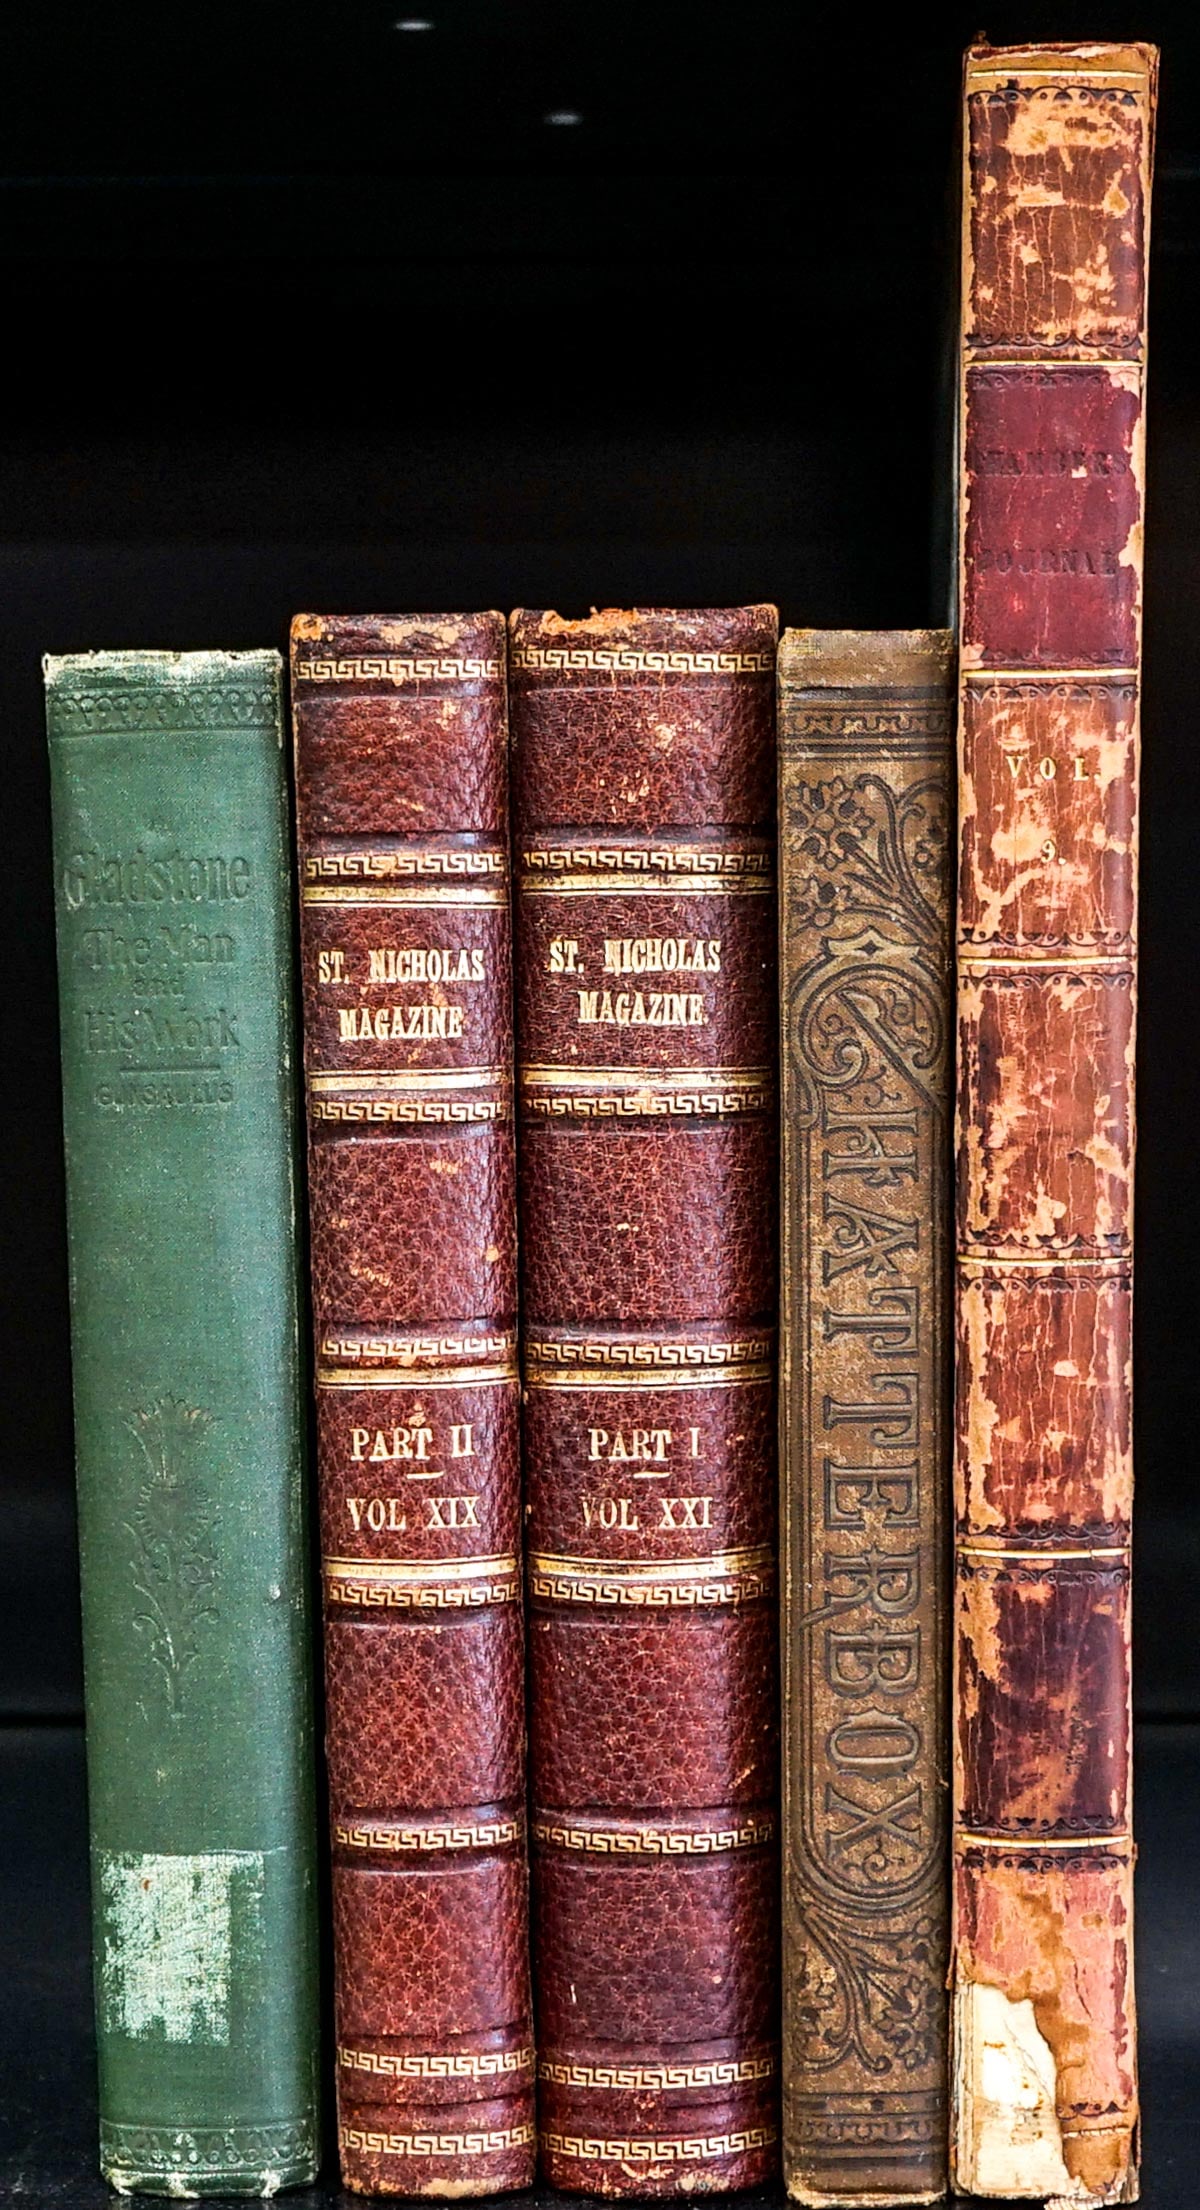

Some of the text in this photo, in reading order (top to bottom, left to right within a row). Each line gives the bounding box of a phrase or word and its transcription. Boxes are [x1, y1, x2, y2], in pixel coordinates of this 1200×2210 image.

[63, 849, 251, 908] Gladstone
[83, 923, 236, 966] The Man
[549, 938, 722, 973] ST. NICHOLAS
[132, 969, 186, 998] and
[318, 949, 486, 984] ST. NICHOLAS
[83, 1006, 241, 1053] His Work
[338, 1006, 464, 1042] MAGAZINE
[790, 926, 948, 1864] CHATTERBOX
[350, 1424, 475, 1462] PART II
[588, 1427, 706, 1462] PART I
[346, 1496, 482, 1531] VOL XIX
[581, 1496, 714, 1531] VOL XXI
